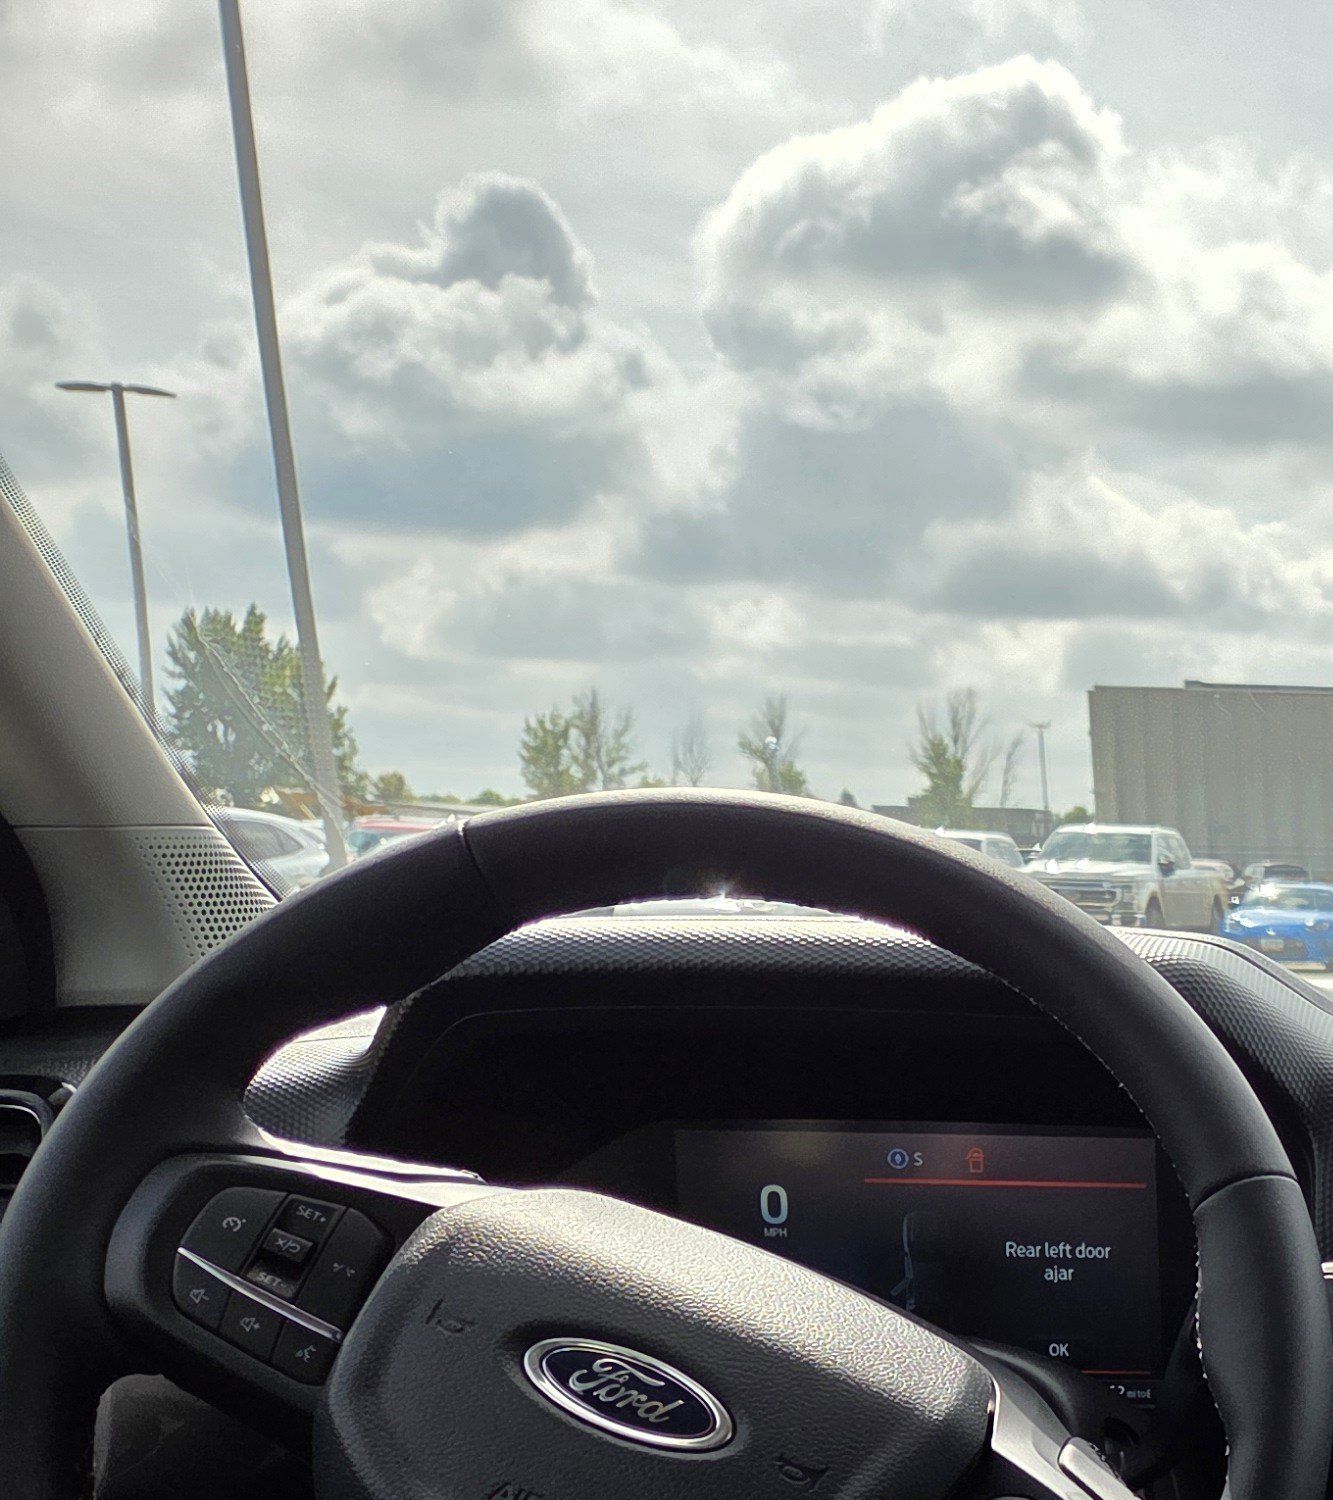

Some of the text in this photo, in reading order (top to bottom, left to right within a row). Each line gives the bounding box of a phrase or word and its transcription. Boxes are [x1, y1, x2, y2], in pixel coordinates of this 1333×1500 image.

[913, 1152, 923, 1167] S
[760, 1184, 789, 1224] 0
[763, 1227, 788, 1238] MPH
[1005, 1240, 1111, 1259] Rear left door
[1043, 1263, 1074, 1283] ajar
[1048, 1343, 1069, 1358] OK
[568, 1358, 685, 1423] Ford
